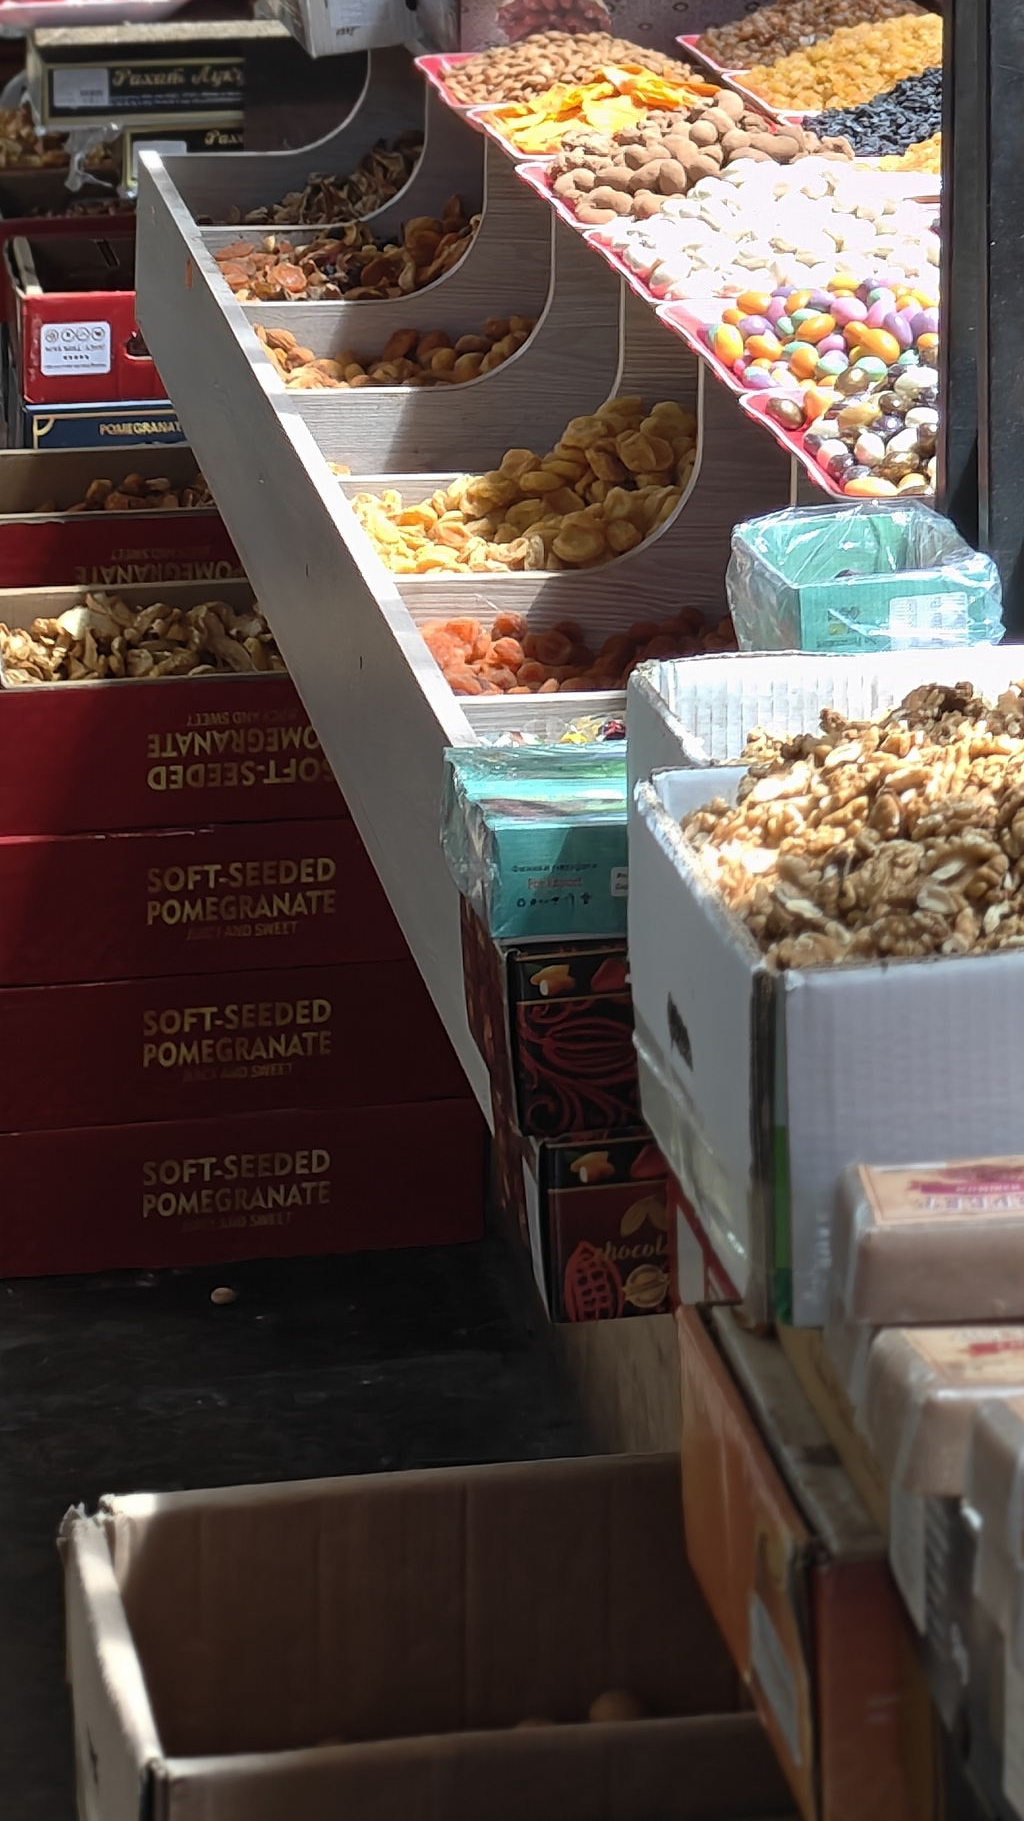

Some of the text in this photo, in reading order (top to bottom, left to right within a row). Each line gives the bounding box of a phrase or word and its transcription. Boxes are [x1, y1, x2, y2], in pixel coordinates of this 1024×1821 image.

[99, 421, 182, 436] POMEGRANAT
[76, 560, 244, 585] OMEGRANATE
[147, 725, 321, 758] OMEGRANATE
[148, 857, 337, 893] SOFT-SEEDED
[147, 889, 336, 925] POMEGRANATE
[143, 999, 332, 1036] SOFT-SEEDED
[142, 1030, 332, 1068] POMEGRANATE
[142, 1149, 331, 1186] SOFT-SEEDED
[142, 1181, 331, 1218] POMEGRANATE
[595, 1234, 669, 1262] chocol
